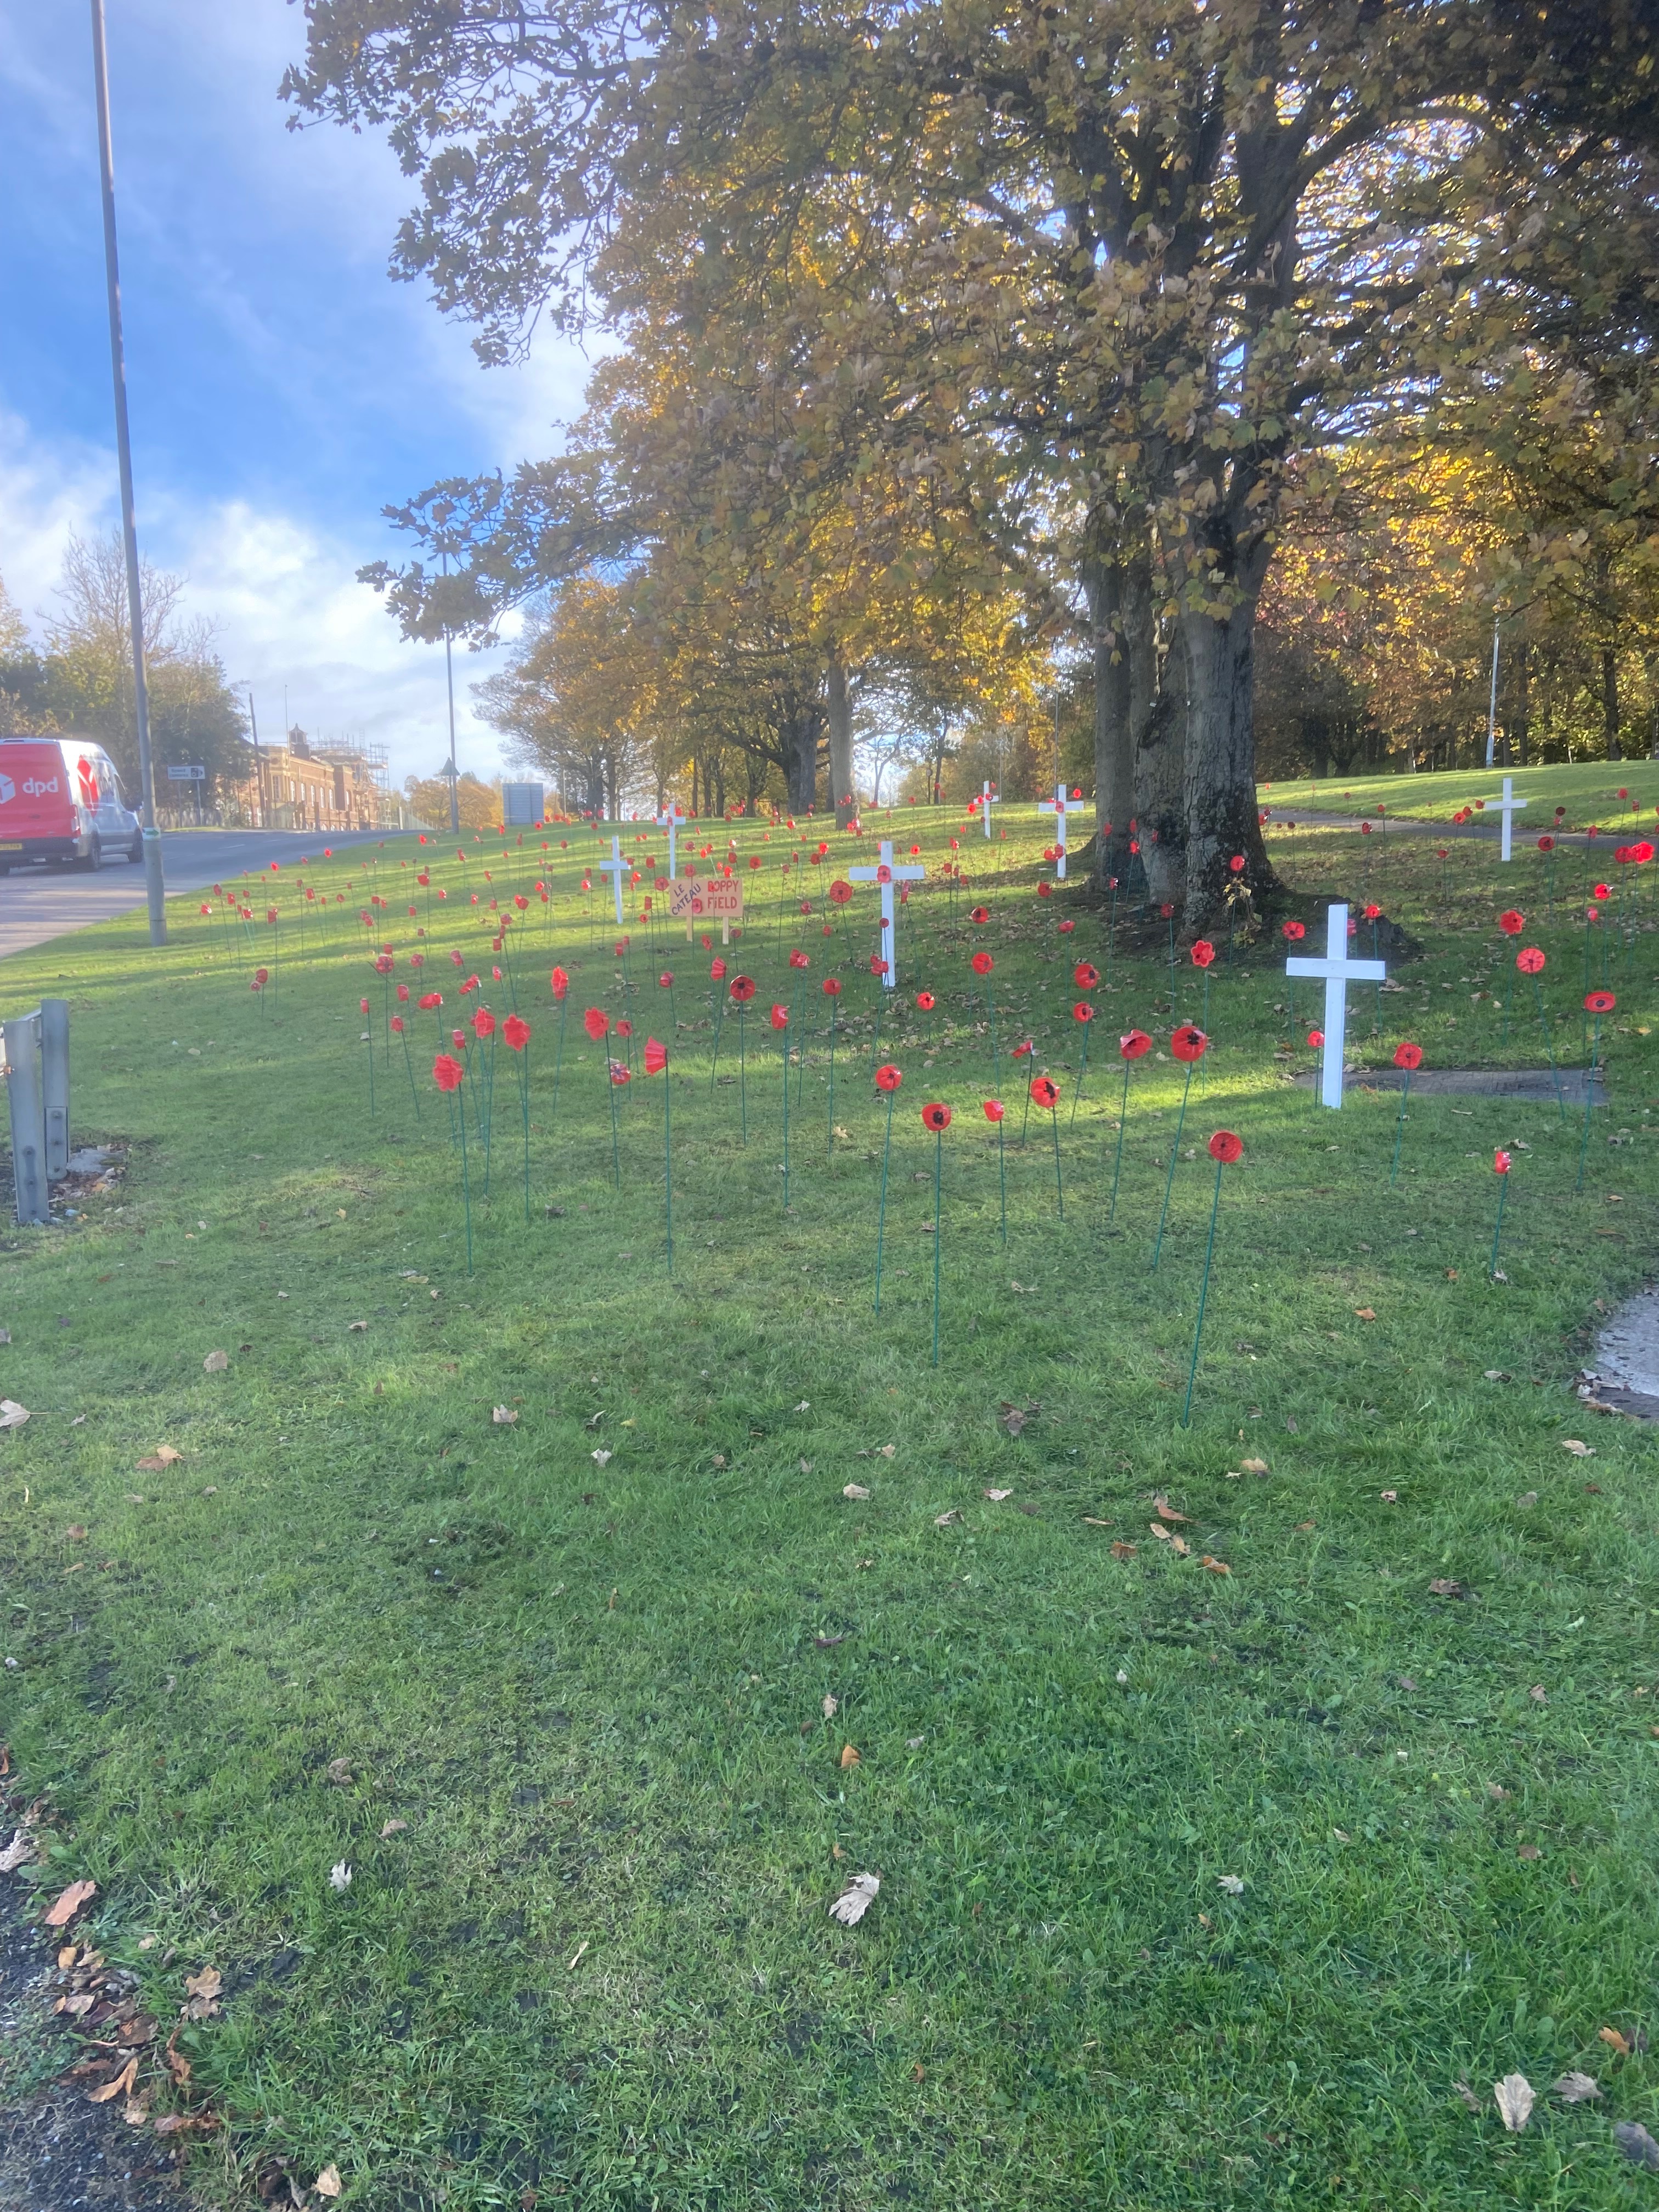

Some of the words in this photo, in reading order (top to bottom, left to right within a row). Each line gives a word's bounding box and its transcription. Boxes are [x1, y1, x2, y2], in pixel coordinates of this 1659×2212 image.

[22, 776, 58, 797] dpd
[672, 883, 701, 915] CATEAU
[673, 884, 685, 898] LE
